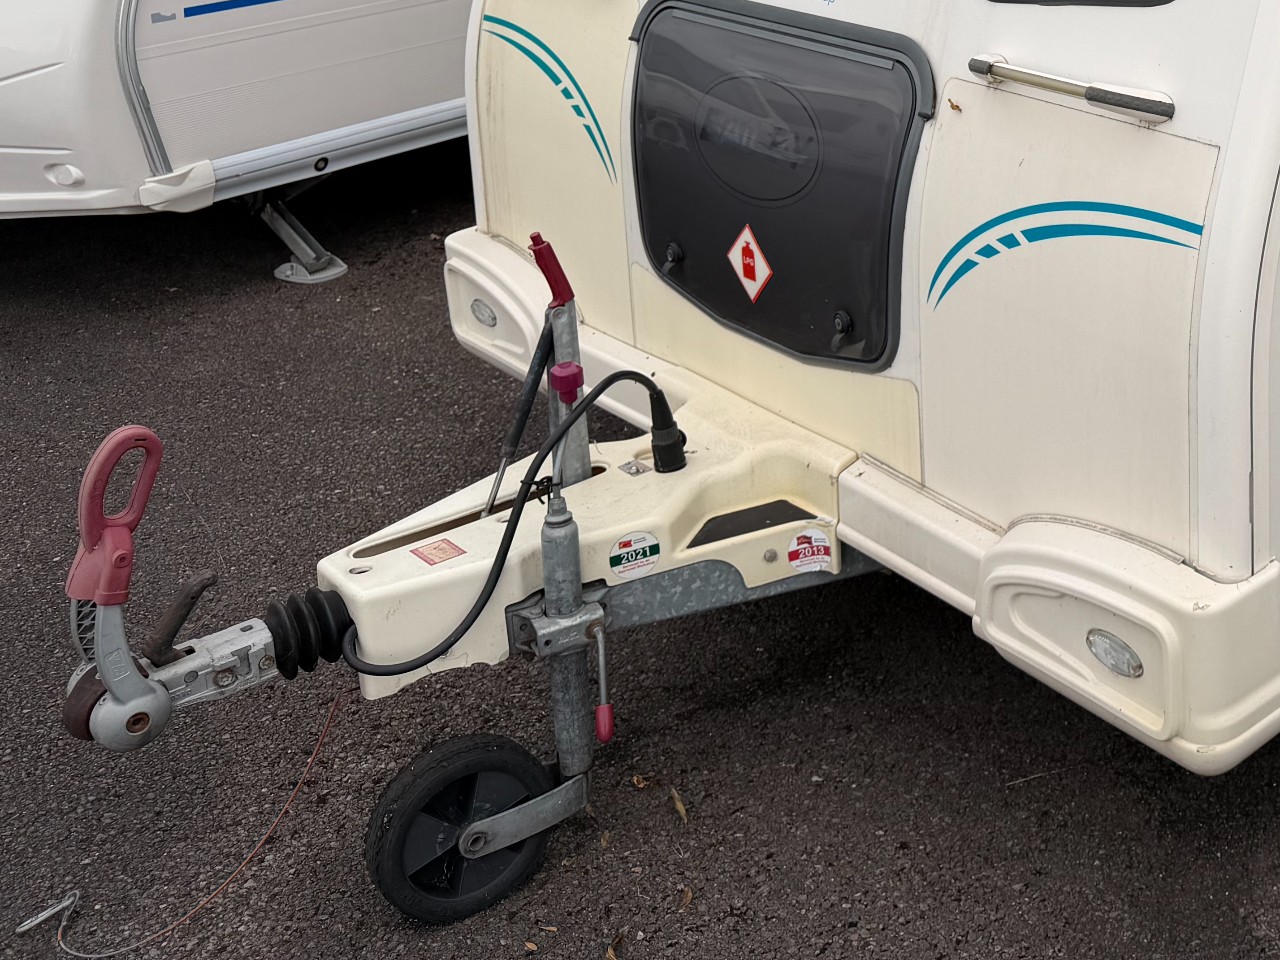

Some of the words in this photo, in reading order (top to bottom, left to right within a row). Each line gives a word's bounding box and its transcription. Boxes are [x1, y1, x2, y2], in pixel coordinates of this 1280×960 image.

[743, 256, 754, 266] LPG
[621, 546, 650, 563] 2021
[798, 546, 825, 558] 2013
